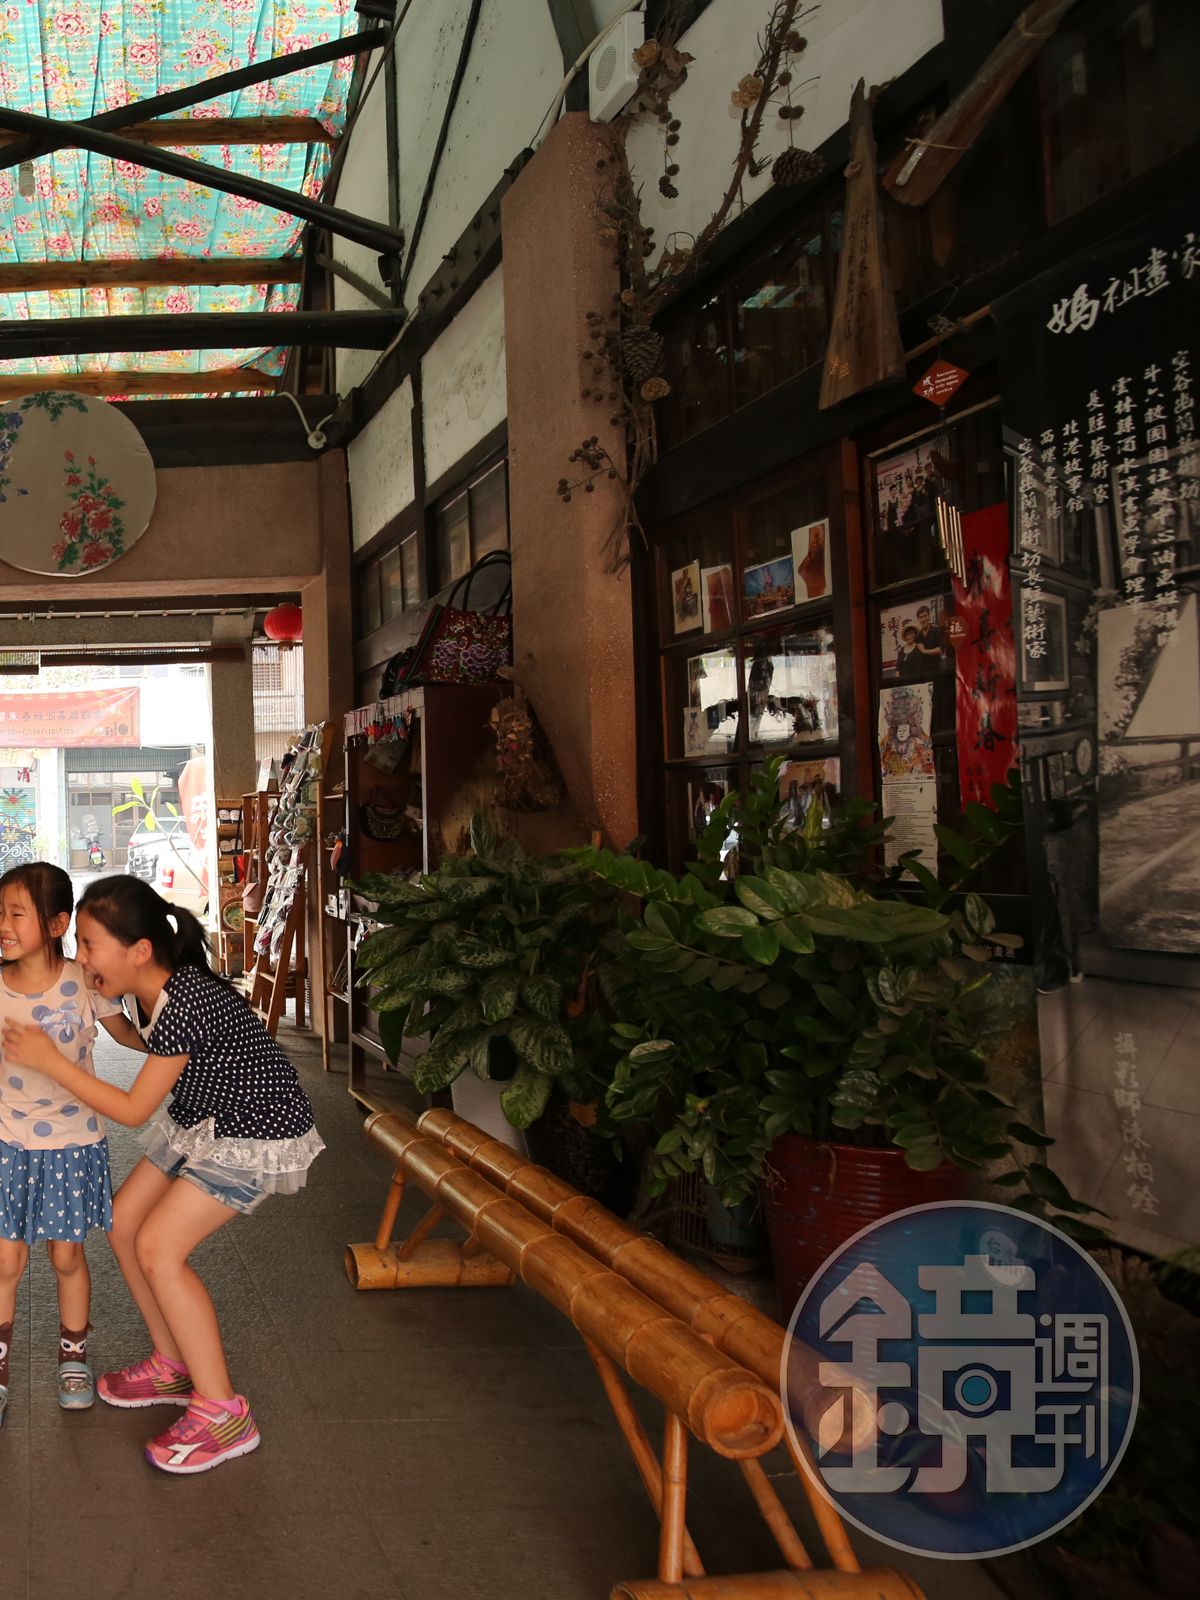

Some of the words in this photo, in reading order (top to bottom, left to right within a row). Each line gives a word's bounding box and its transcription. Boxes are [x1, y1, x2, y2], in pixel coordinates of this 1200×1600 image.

[1046, 232, 1200, 335] 媽祖畫家
[1062, 419, 1085, 513] 北港故事館
